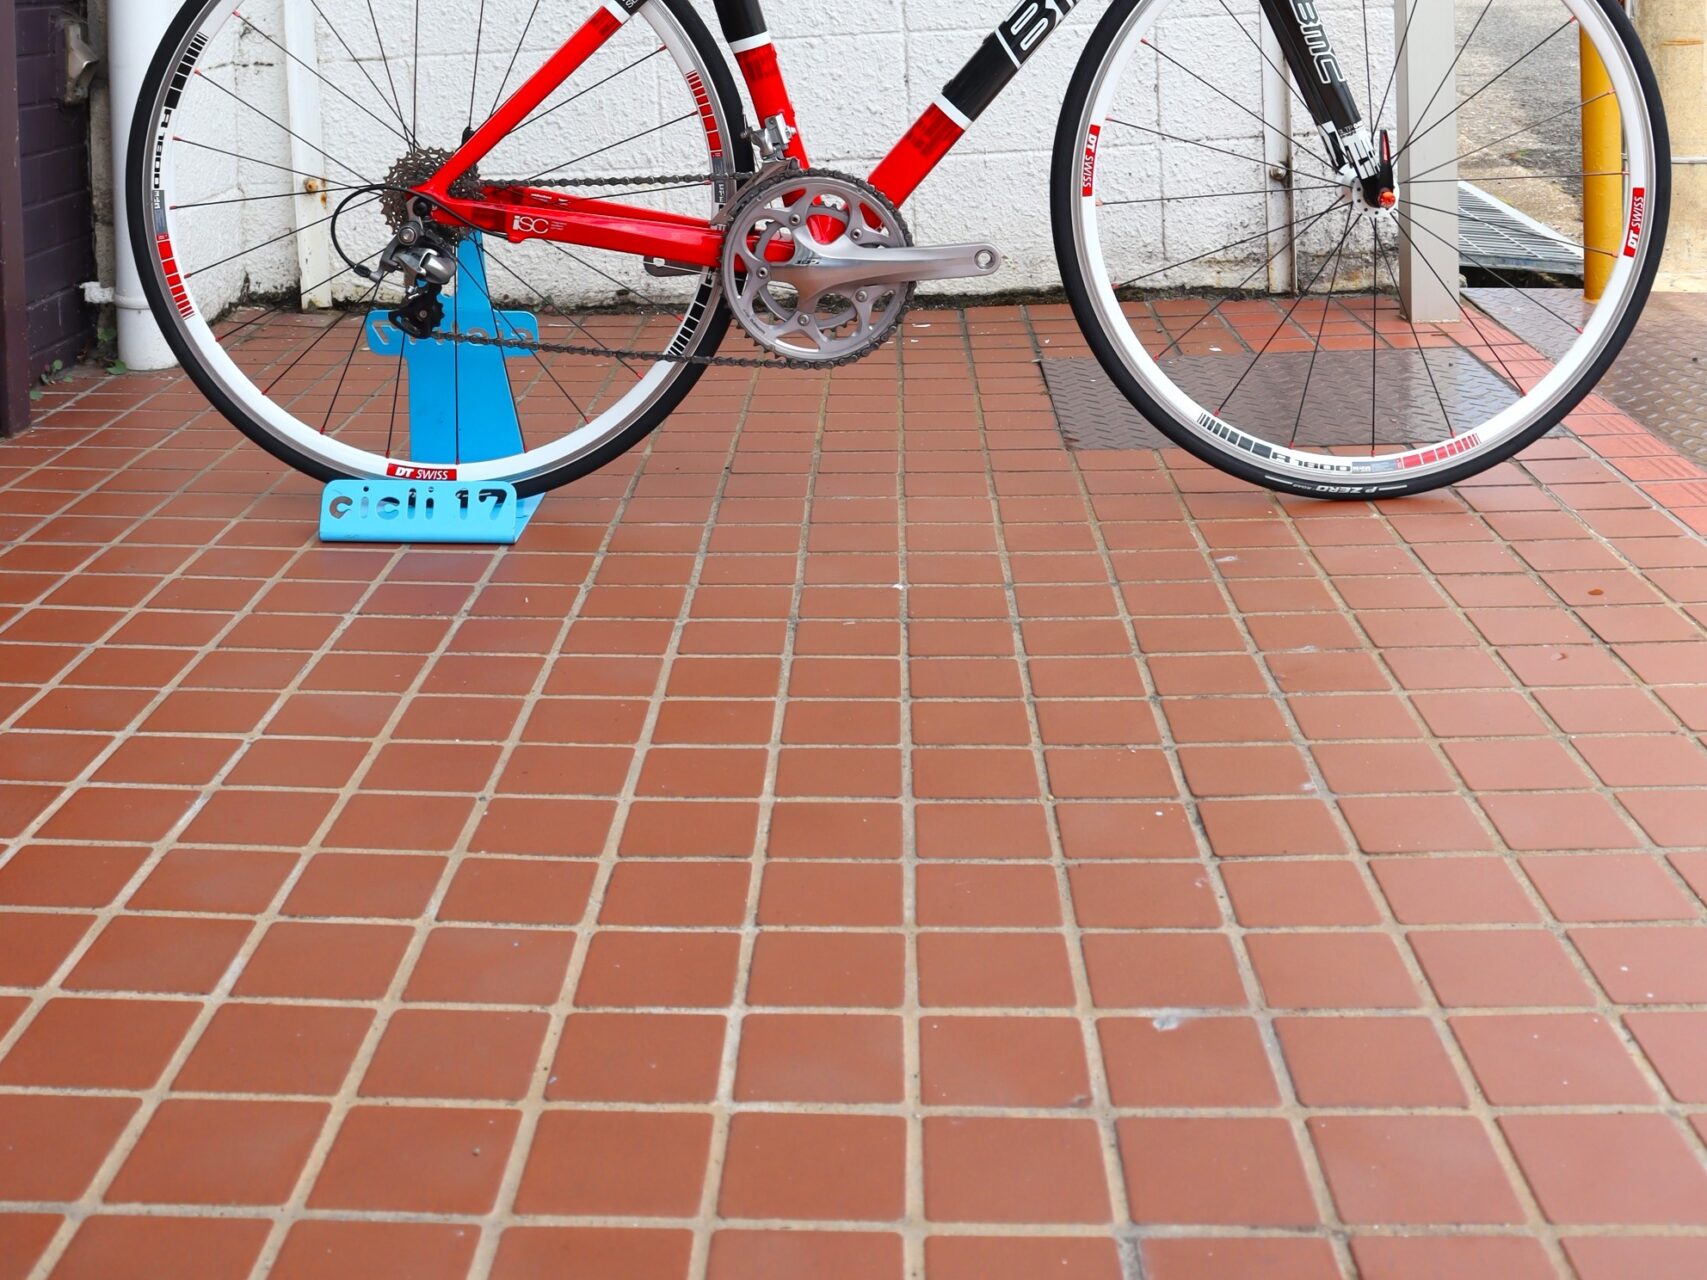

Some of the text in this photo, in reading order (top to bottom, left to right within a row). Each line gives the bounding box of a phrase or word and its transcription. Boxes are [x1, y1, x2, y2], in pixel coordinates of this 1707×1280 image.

[1082, 133, 1097, 188] DT SWISS
[1627, 196, 1644, 248] DT SWISS
[394, 467, 449, 481] DT SWISS
[1315, 485, 1363, 494] ZERO
[329, 486, 508, 520] cicli 17
